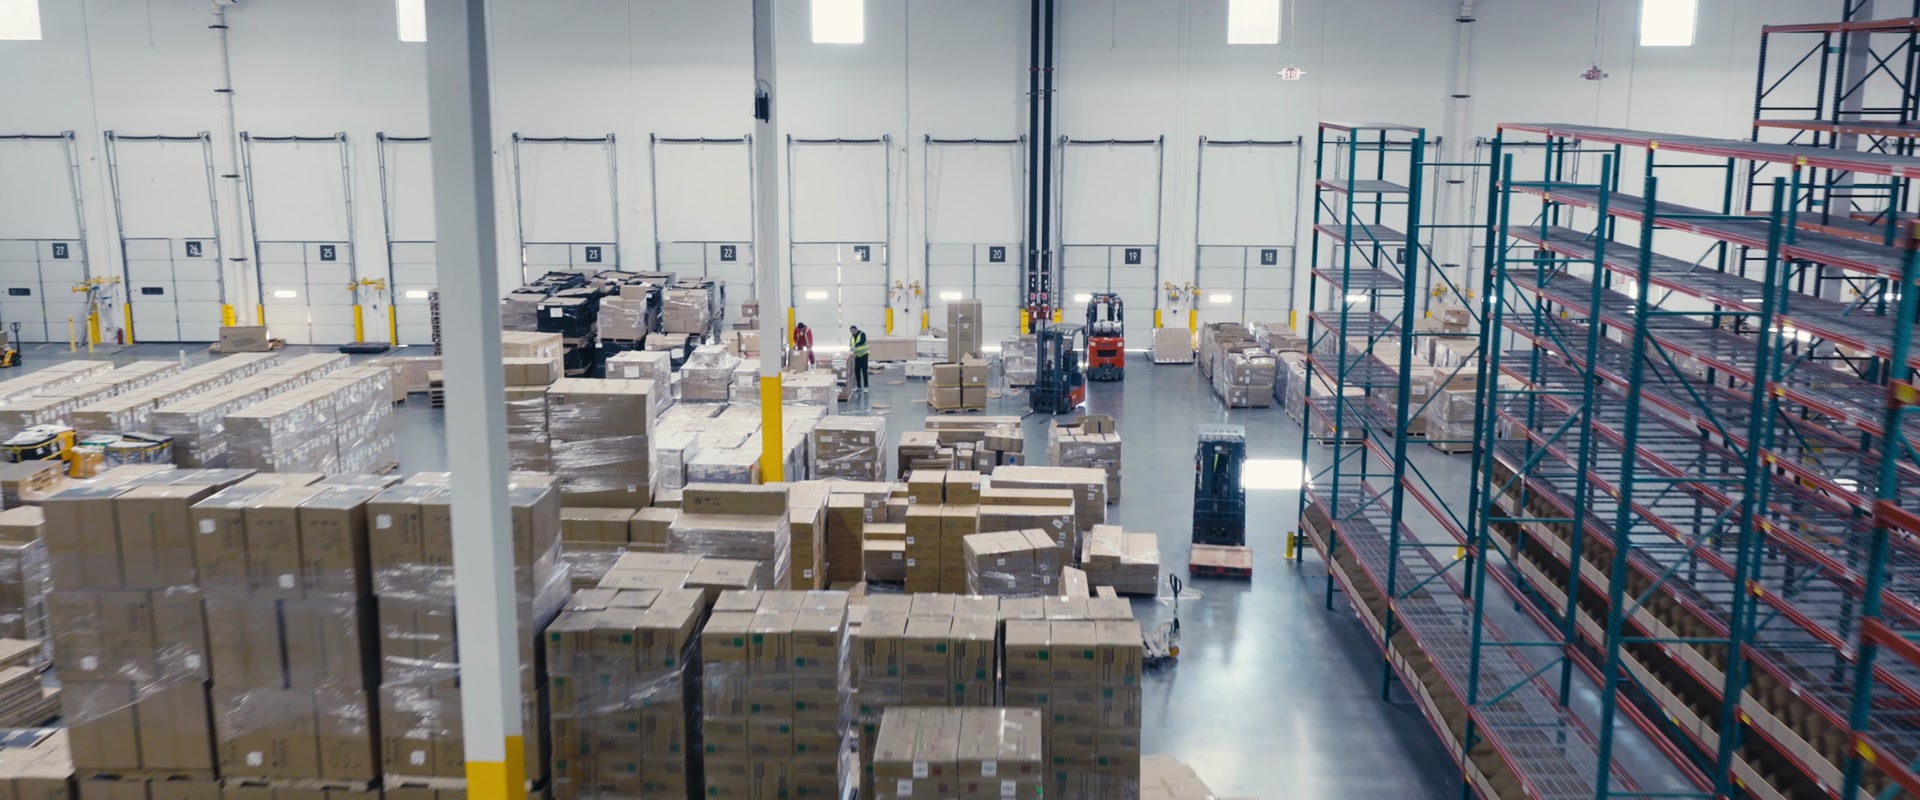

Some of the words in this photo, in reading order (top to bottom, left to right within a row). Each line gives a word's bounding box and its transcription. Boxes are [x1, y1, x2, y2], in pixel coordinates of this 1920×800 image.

[56, 246, 65, 256] 27
[189, 244, 199, 255] 26
[323, 248, 333, 258] 25
[589, 249, 598, 259] 23
[724, 249, 733, 259] 22
[993, 249, 1002, 259] 20
[1129, 251, 1138, 261] 19
[1265, 252, 1273, 262] 18
